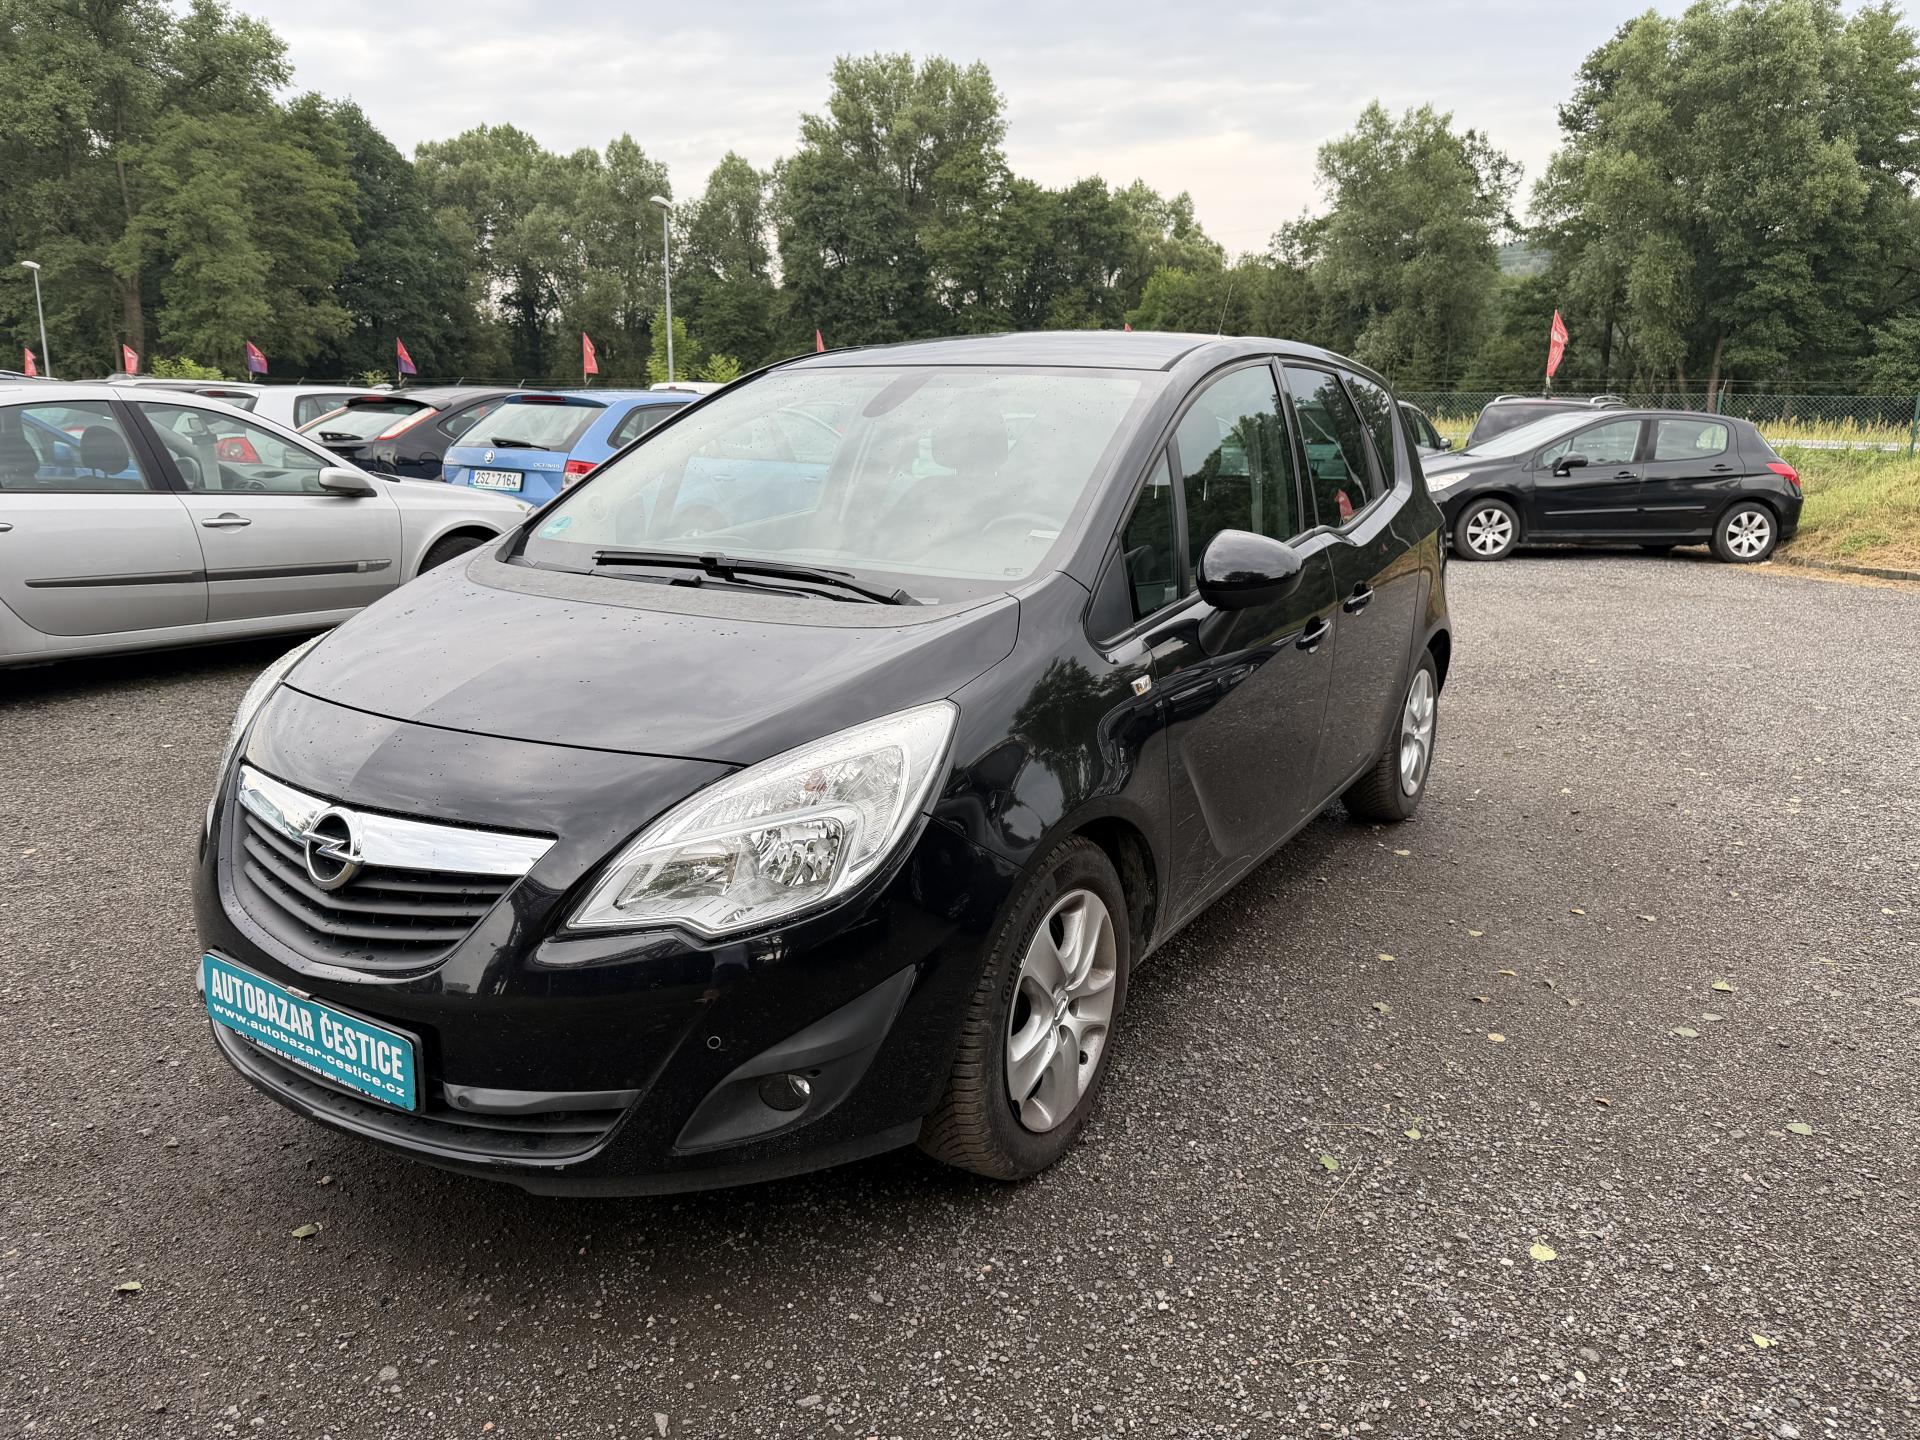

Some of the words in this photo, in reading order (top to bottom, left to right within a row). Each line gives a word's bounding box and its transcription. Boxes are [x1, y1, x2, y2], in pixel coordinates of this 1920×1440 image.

[475, 471, 491, 485] 2SZ
[495, 473, 517, 487] 7164
[211, 967, 315, 1042] AUTOBAZAR
[319, 1010, 405, 1082] ČESTICE
[212, 1002, 405, 1098] www.autobazar-cestice.cz
